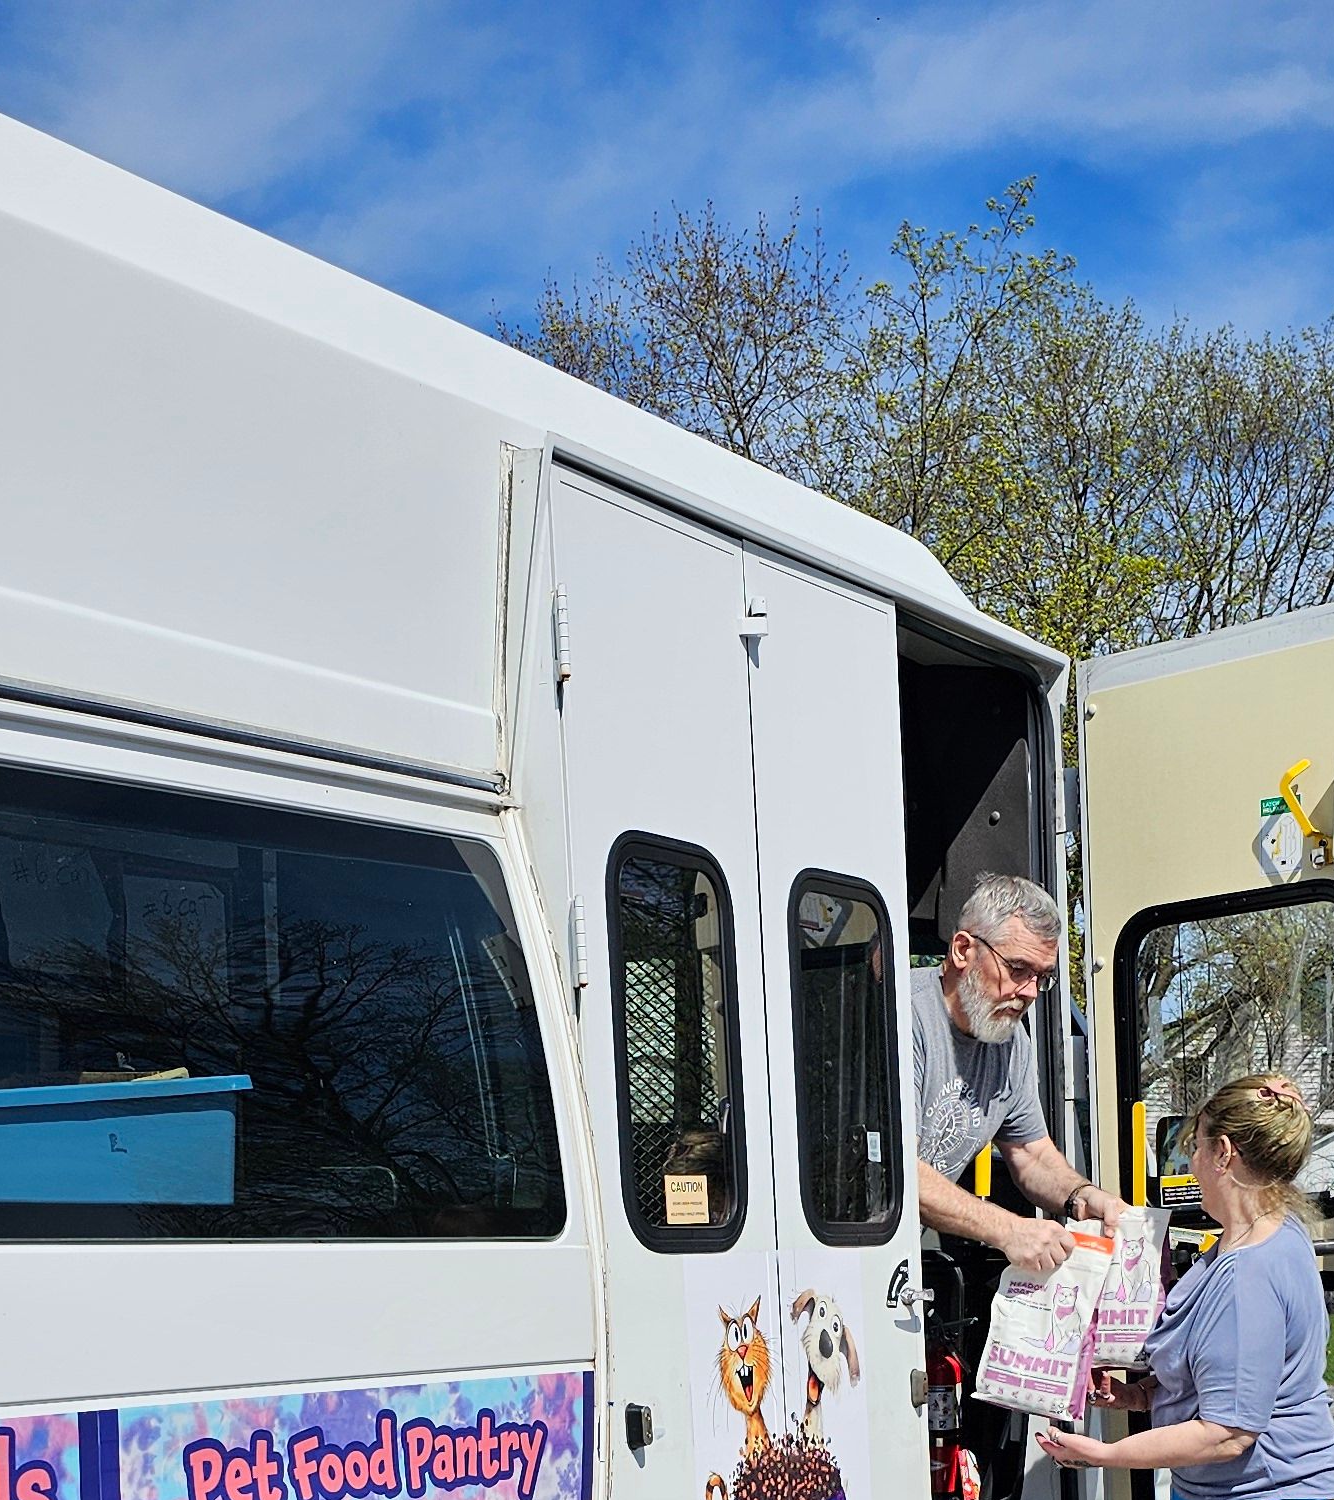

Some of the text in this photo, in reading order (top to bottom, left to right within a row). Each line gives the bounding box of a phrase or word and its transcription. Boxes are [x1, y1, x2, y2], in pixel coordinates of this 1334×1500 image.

[670, 1181, 703, 1192] CAUTION
[1098, 1309, 1148, 1325] MMIT
[988, 1344, 1073, 1378] SUMMIT
[405, 1413, 546, 1499] Pantry
